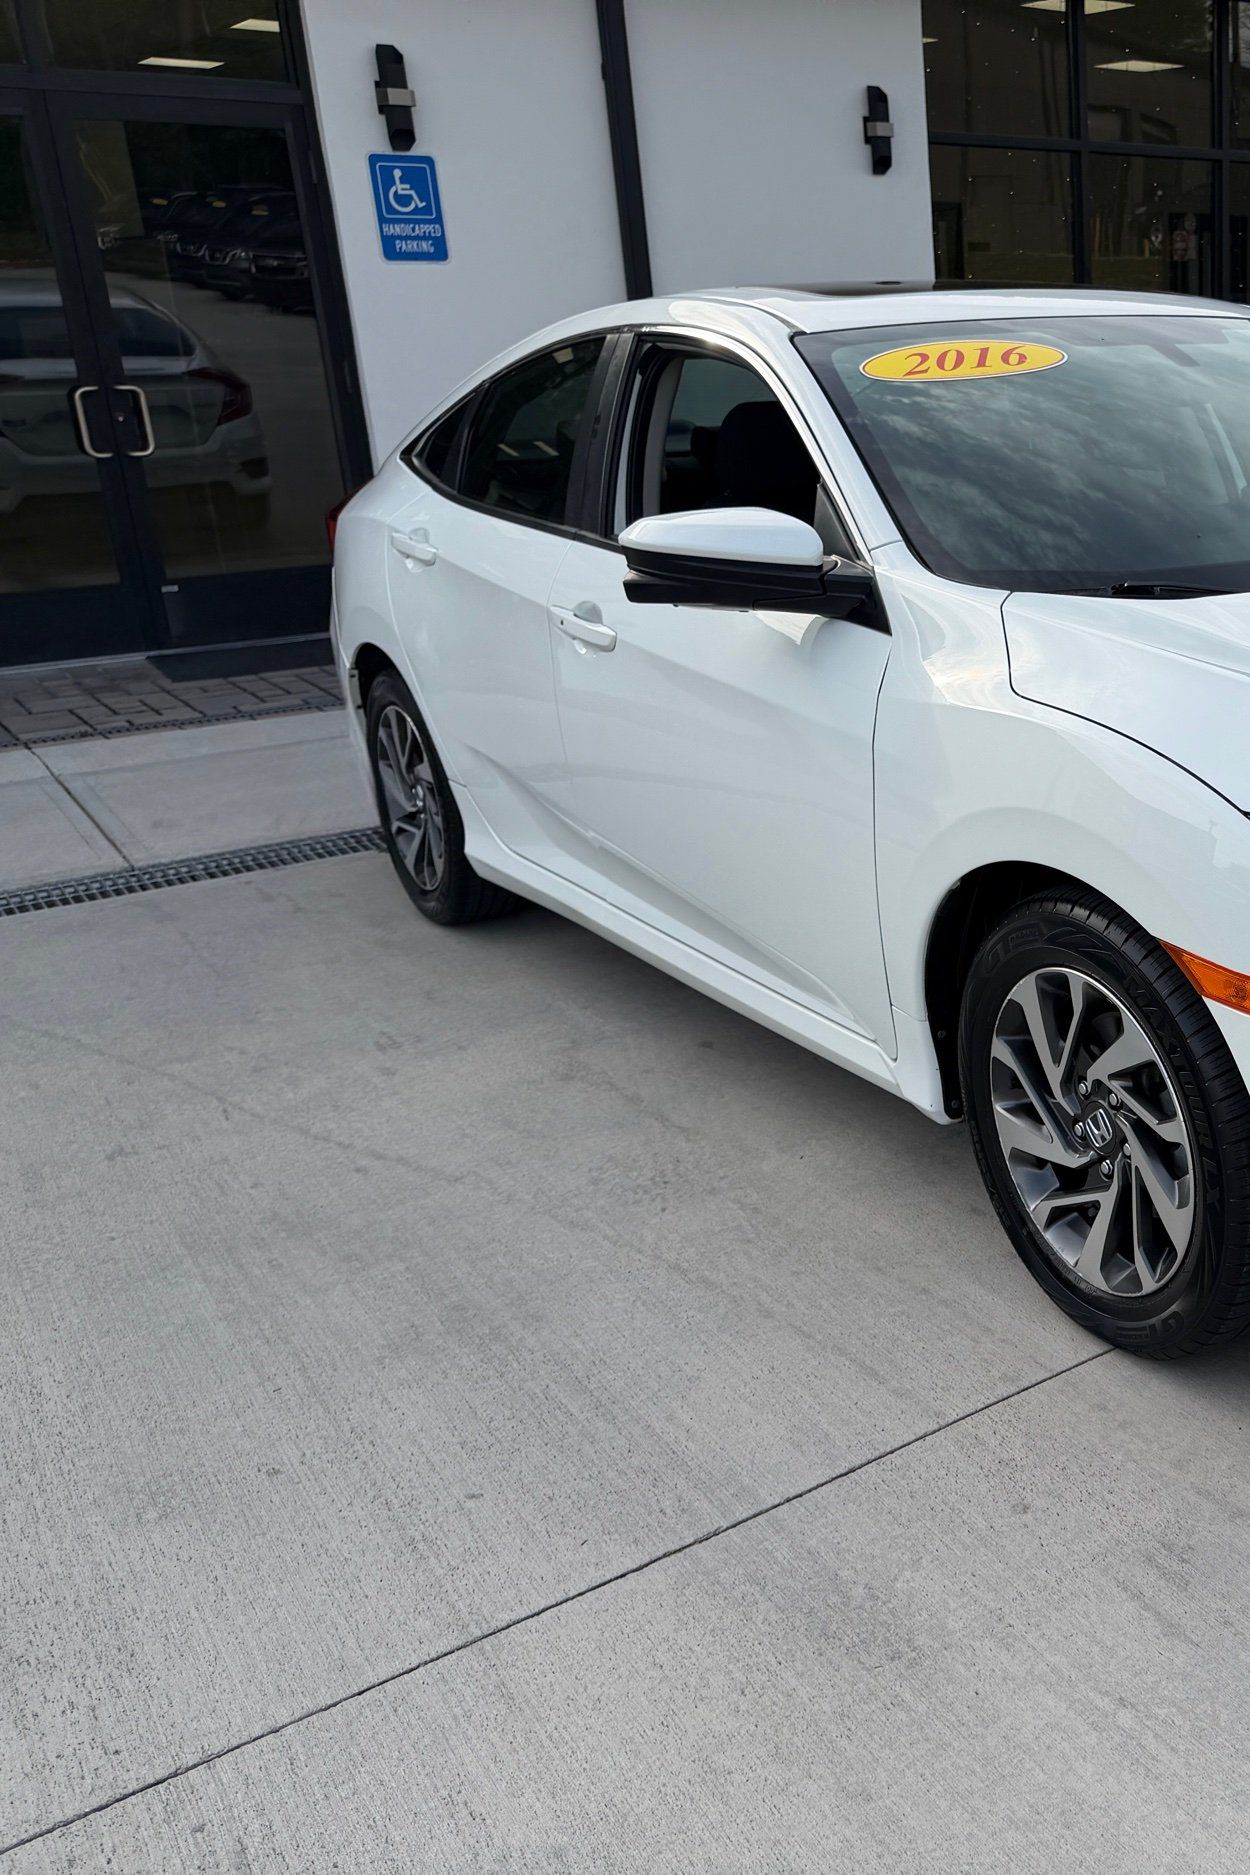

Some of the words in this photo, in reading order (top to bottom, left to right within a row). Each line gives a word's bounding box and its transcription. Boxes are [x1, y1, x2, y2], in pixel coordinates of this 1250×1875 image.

[382, 223, 442, 237] HANDICAPPED
[395, 239, 435, 254] PARKING
[902, 345, 1028, 377] 2016
